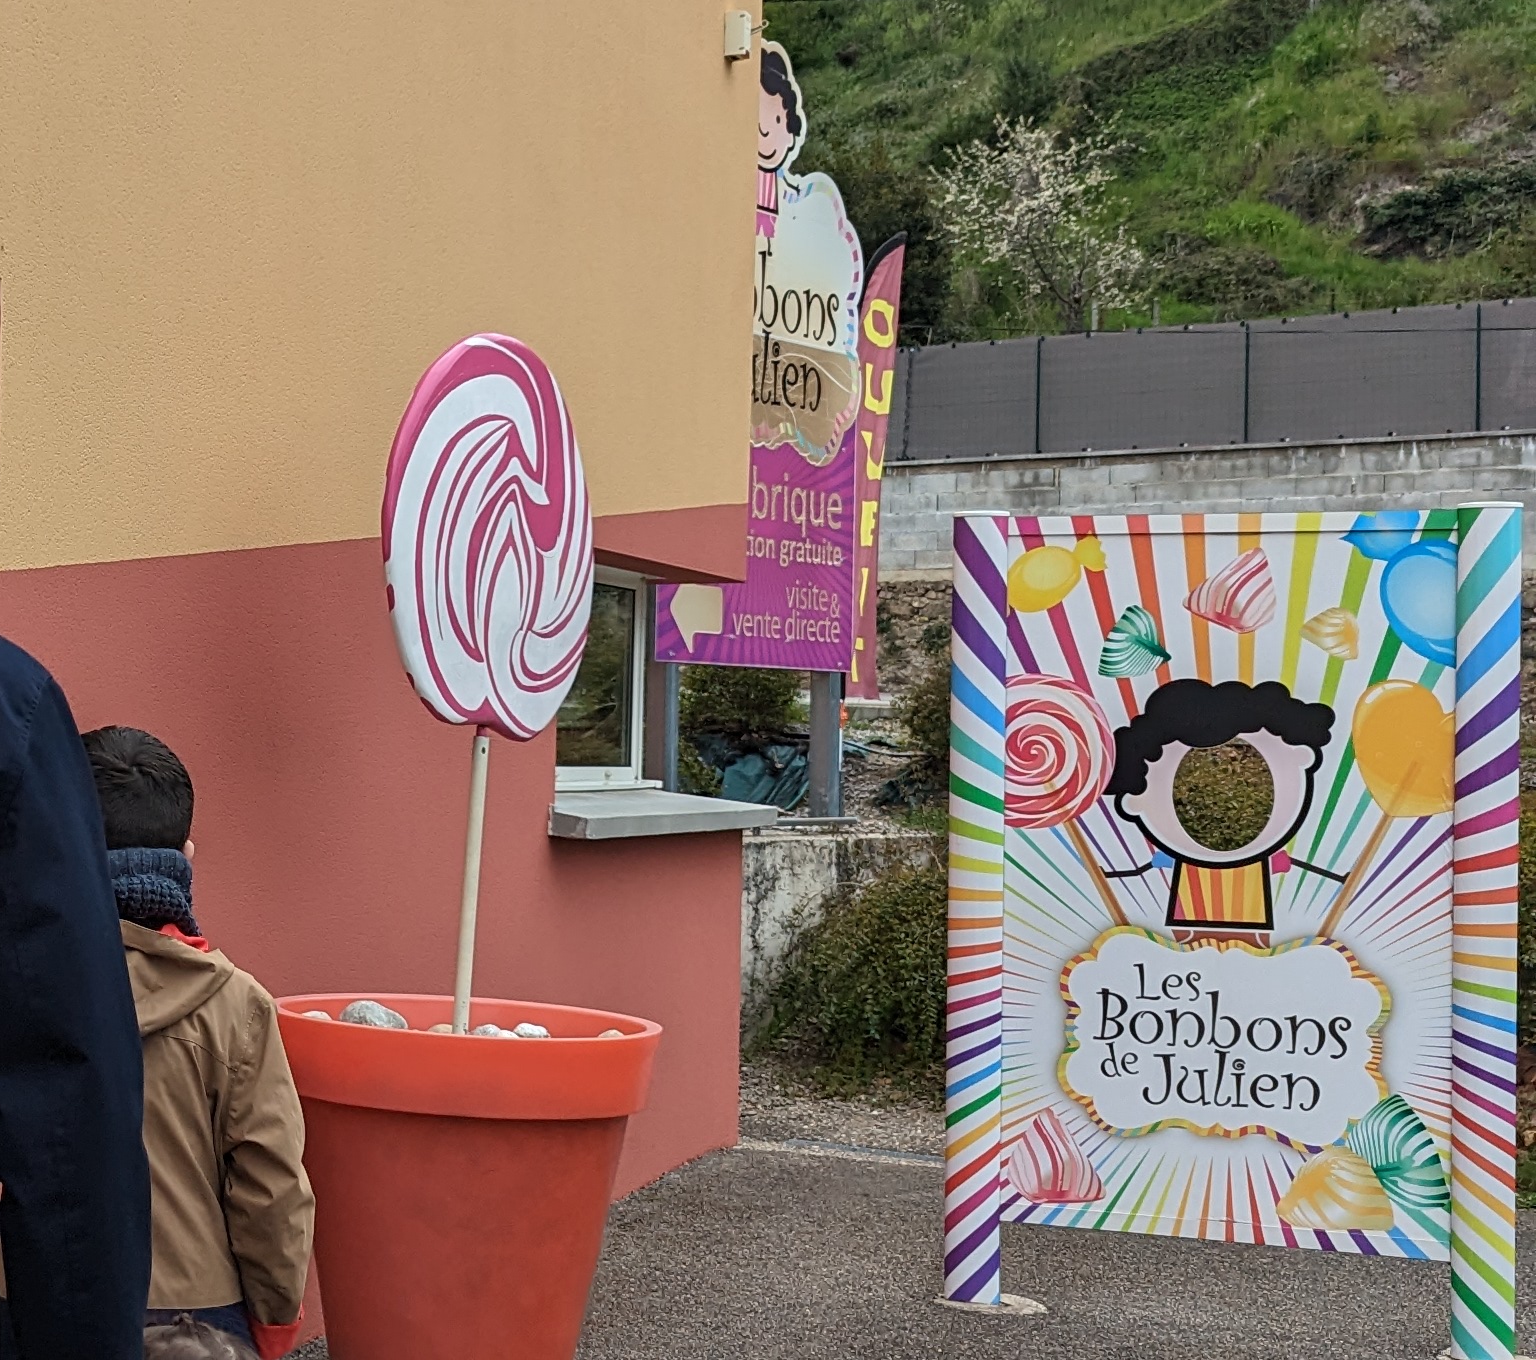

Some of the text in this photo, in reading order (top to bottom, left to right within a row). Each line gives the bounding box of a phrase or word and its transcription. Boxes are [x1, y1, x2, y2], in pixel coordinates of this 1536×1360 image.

[753, 250, 839, 346] bons
[852, 298, 895, 683] OUVE
[779, 537, 843, 567] gratuite
[785, 579, 841, 618] visite &
[732, 609, 841, 643] vente directe
[1133, 963, 1202, 1002] Les
[1092, 987, 1352, 1060] Bonbons
[1100, 1042, 1321, 1112] de Julien
